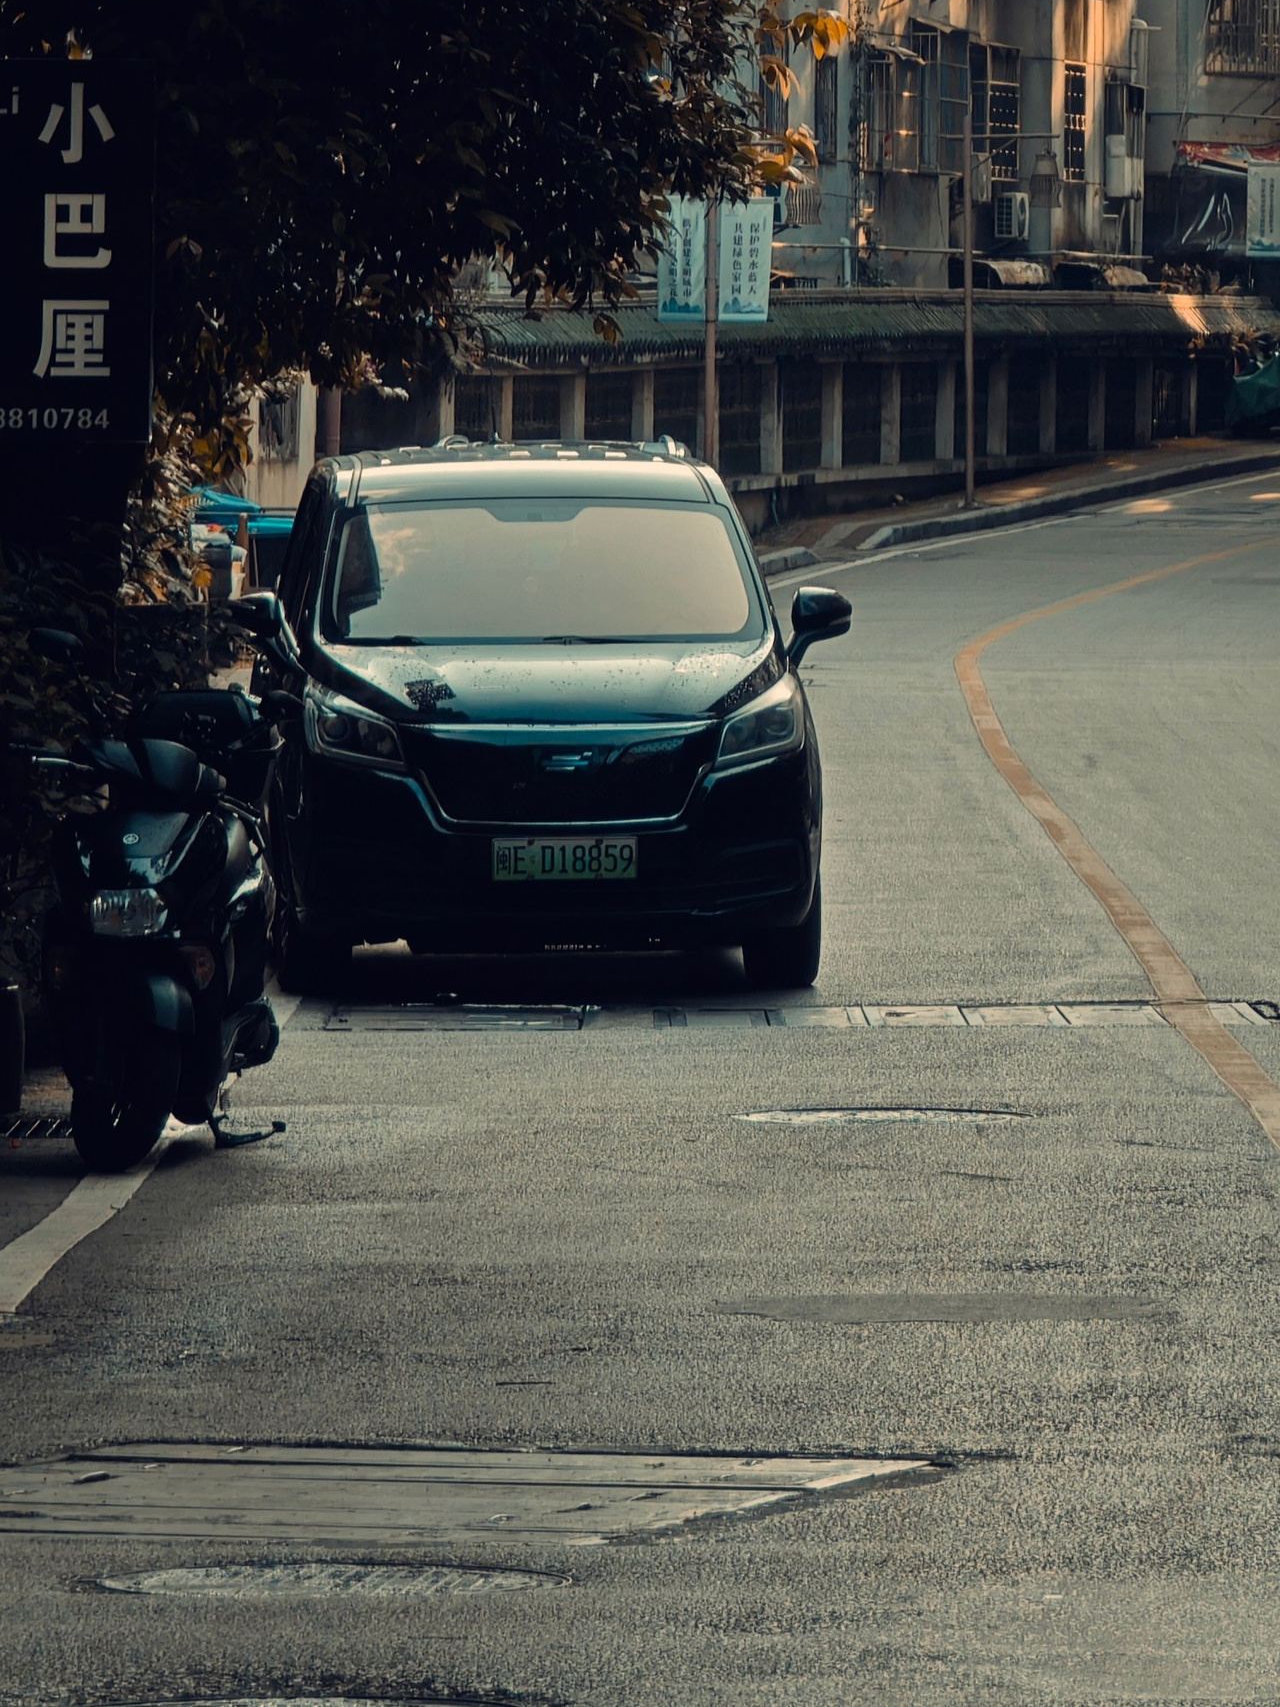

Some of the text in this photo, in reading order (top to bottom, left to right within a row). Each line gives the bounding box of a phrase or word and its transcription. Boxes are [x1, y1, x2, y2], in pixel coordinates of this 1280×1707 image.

[0, 87, 19, 114] i
[33, 81, 116, 379] 小巴厘
[731, 222, 743, 296] 共建绿色家园
[747, 222, 760, 296] 保护碧水蓝天
